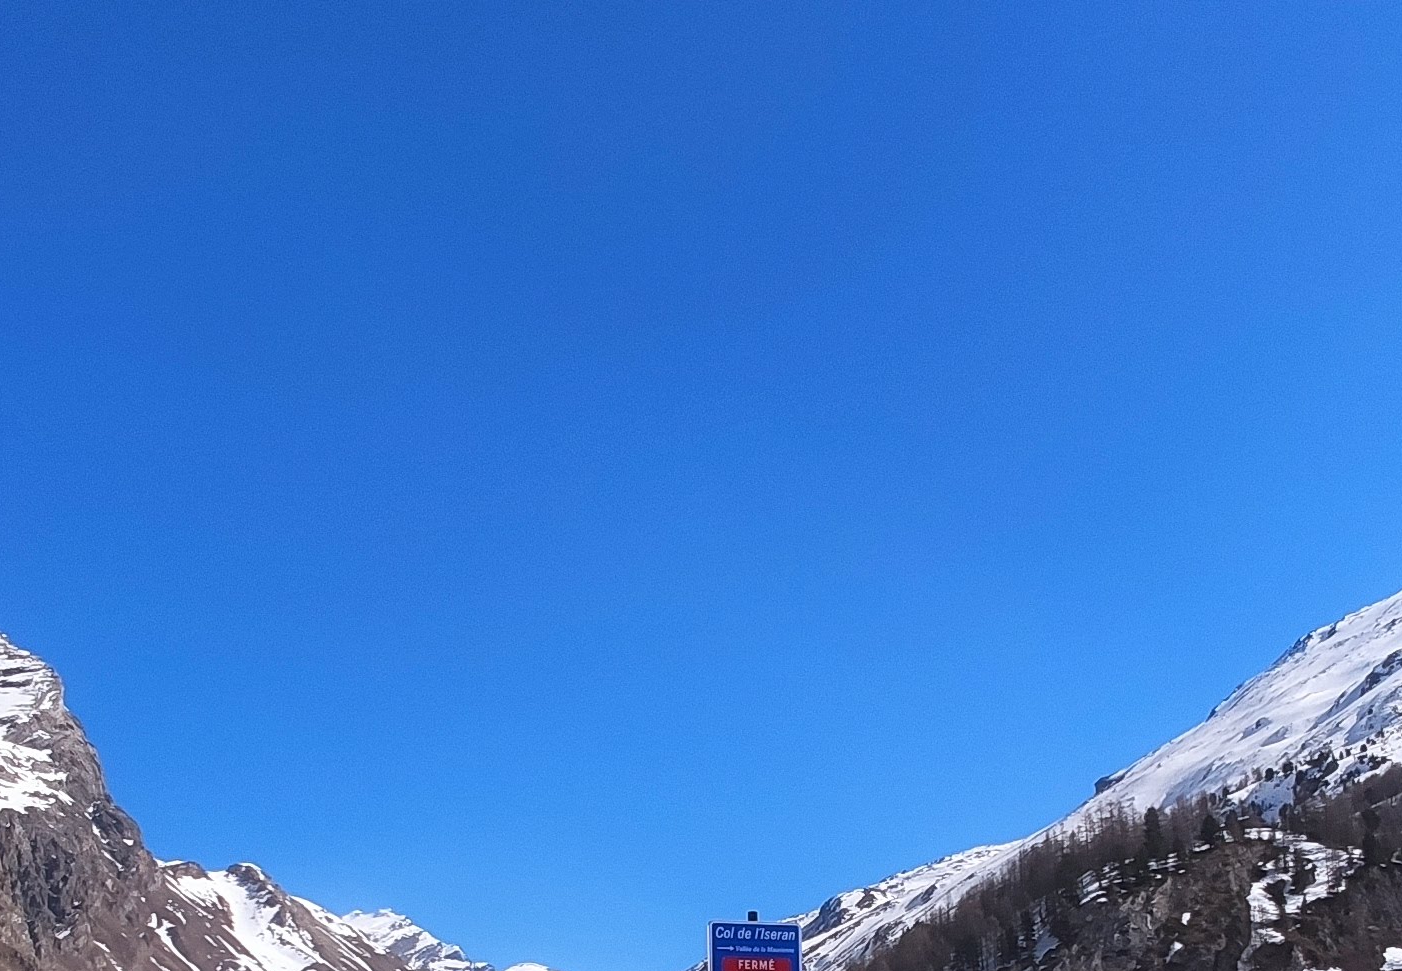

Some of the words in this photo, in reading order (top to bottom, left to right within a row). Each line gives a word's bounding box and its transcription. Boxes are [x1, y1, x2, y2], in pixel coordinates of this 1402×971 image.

[716, 927, 734, 938] Col
[737, 927, 752, 939] de
[754, 927, 796, 941] l'Iseran
[738, 959, 775, 970] FERMÉ
